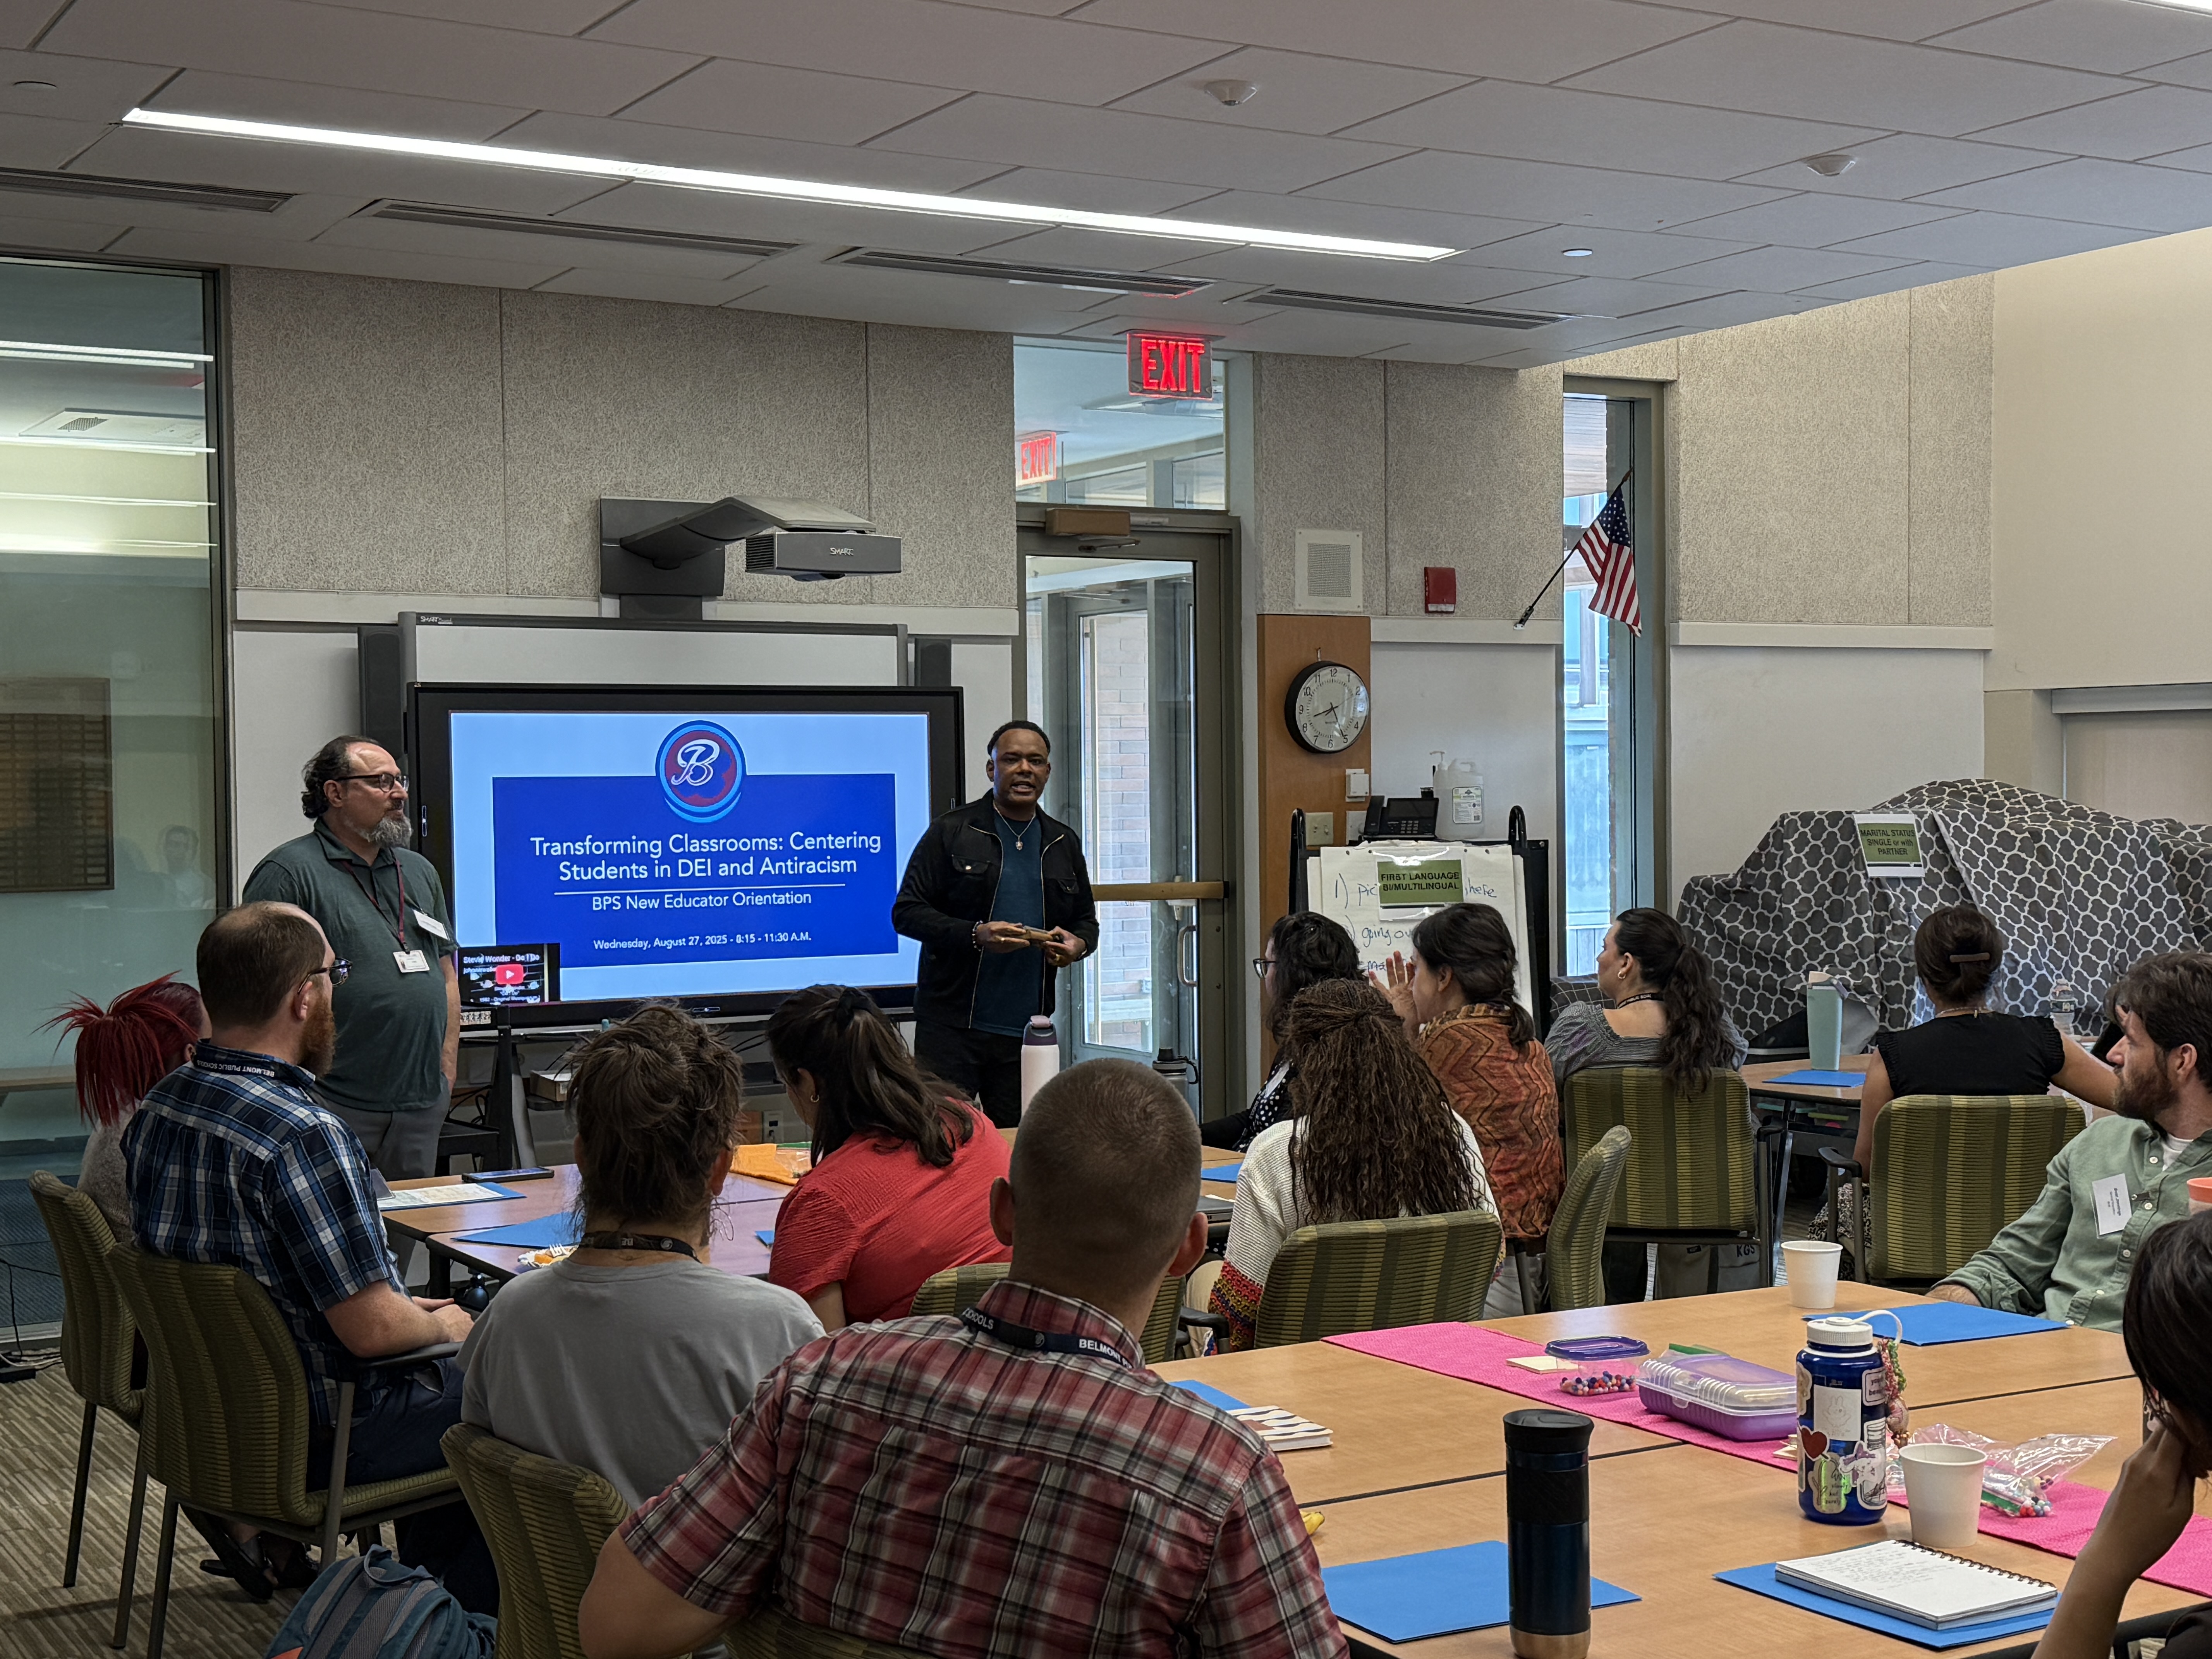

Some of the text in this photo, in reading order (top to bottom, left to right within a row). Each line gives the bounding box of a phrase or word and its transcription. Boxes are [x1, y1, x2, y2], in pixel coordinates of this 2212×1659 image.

[1141, 338, 1204, 393] EXIT
[1021, 436, 1051, 480] EXIT
[1330, 668, 1338, 677] 12
[1315, 673, 1321, 683] 11
[1347, 674, 1350, 683] 1
[1356, 686, 1361, 696] 2
[1299, 704, 1304, 714] 9
[1302, 723, 1307, 733] 8
[1354, 721, 1358, 730] 4
[1314, 735, 1319, 744] 7
[1343, 734, 1348, 743] 5
[1328, 739, 1333, 749] 6
[671, 739, 720, 786] B
[530, 831, 881, 858] Transforming Classrooms: Centering
[559, 855, 857, 881] Students in DEI and Antiracism
[1409, 872, 1459, 880] LANGUAGE
[1383, 882, 1460, 891] BI/MULTILINGUAL
[1357, 883, 1378, 906] pic
[592, 891, 812, 910] BPS New Educator Orientation
[593, 938, 651, 950] Wednesday,
[653, 938, 686, 949] August
[688, 936, 703, 946] 27,
[705, 934, 728, 945] 2025
[764, 932, 788, 942] 11:30
[790, 931, 812, 941] A.M.
[1362, 924, 1392, 948] going
[530, 953, 540, 962] Do
[218, 1063, 241, 1072] PUBLIC
[242, 1066, 275, 1077] BELMONT
[1079, 1338, 1121, 1362] BELMONT
